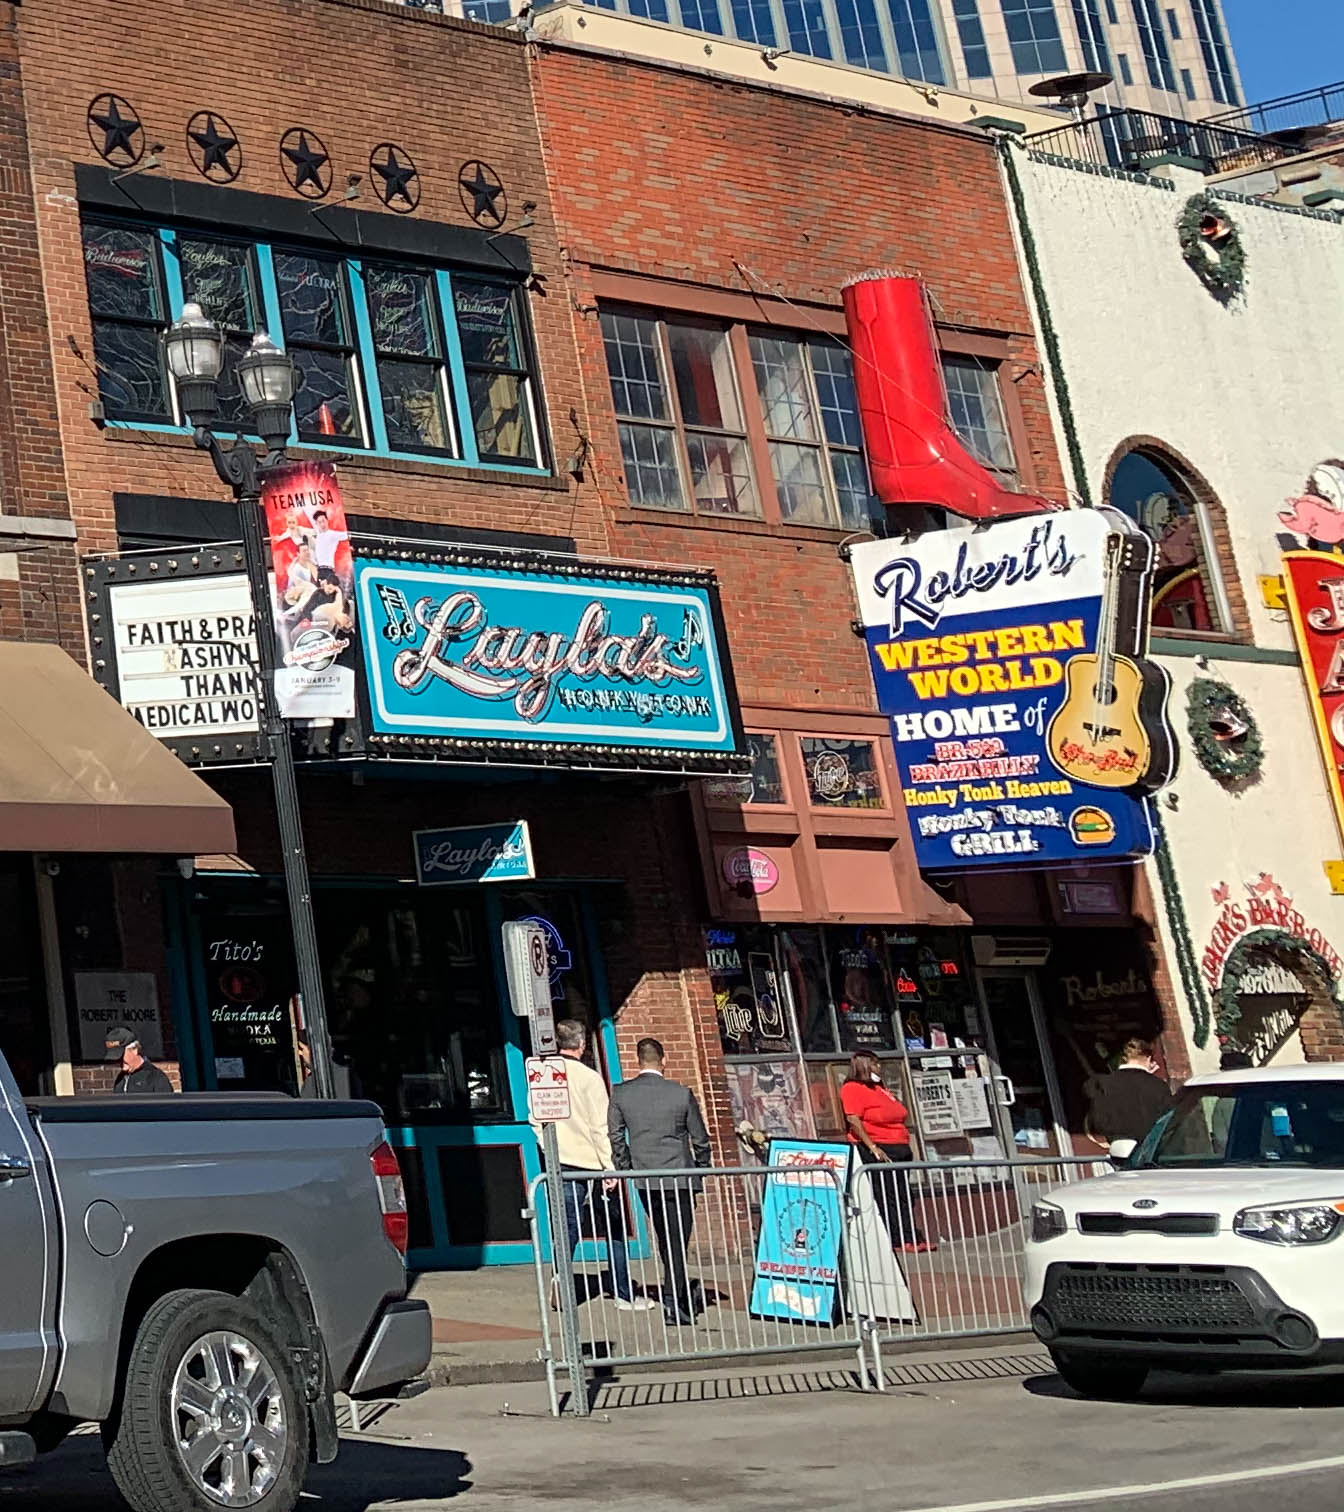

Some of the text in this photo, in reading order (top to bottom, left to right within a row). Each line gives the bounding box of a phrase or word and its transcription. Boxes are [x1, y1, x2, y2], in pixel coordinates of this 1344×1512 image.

[272, 489, 335, 510] TEAM USA
[873, 520, 1085, 639] Robert's
[128, 619, 192, 645] FAITH
[199, 619, 213, 640] &
[875, 619, 1086, 672] WESTERN
[393, 591, 704, 724] Layla's
[907, 657, 1064, 700] WORLD
[894, 697, 1048, 742] HOME of
[903, 785, 958, 808] Honky
[959, 780, 1005, 803] Tonk
[1004, 778, 1073, 799] Heaven
[950, 829, 1040, 856] GRILL
[209, 939, 264, 962] Tito's
[108, 990, 127, 1003] THE
[212, 1004, 282, 1023] Handmade
